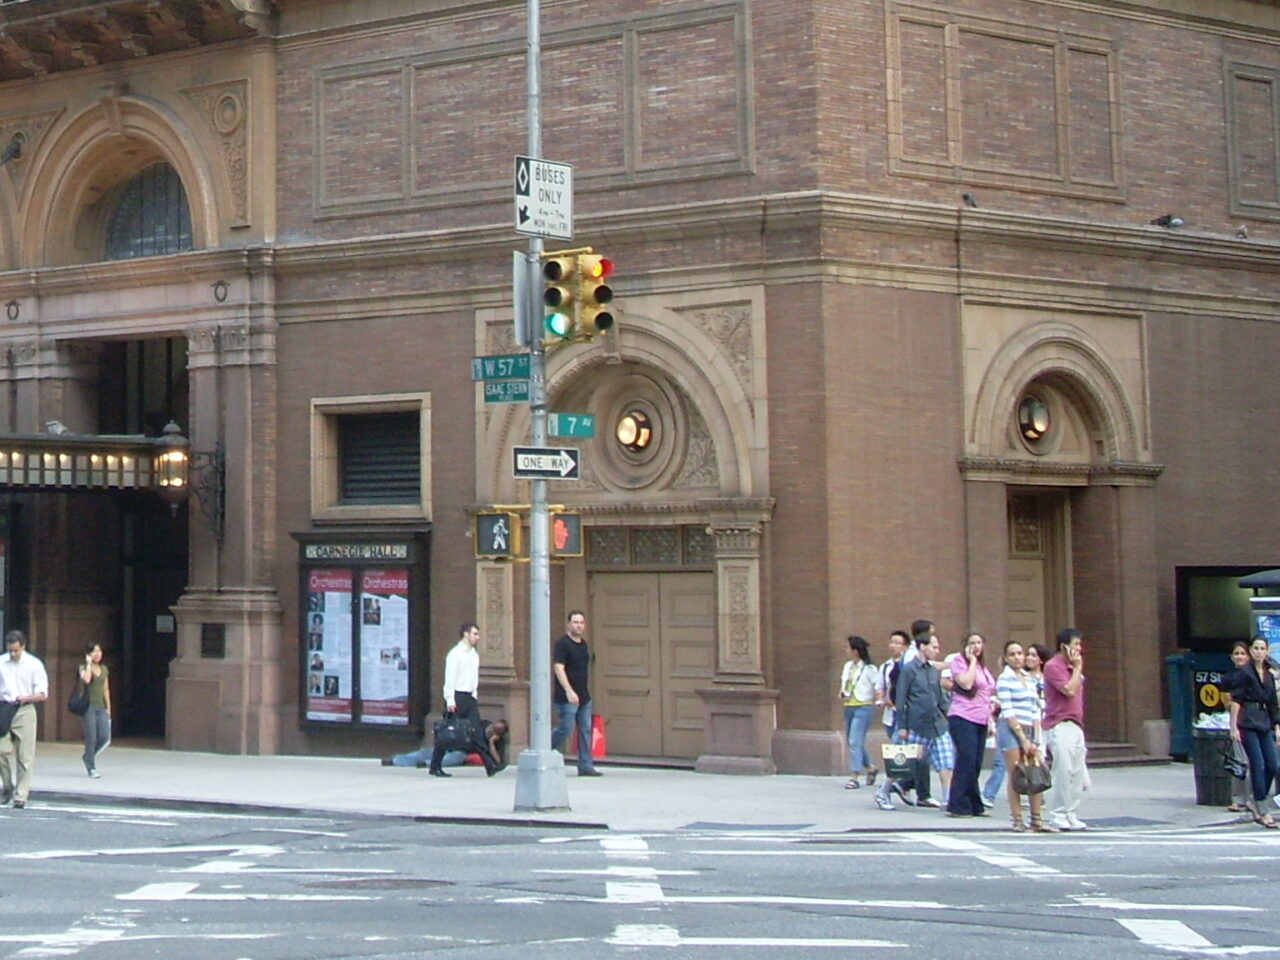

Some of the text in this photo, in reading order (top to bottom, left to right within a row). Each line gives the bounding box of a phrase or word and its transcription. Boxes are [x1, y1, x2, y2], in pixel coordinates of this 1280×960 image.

[535, 167, 565, 185] BUSES
[538, 188, 562, 204] ONLY
[484, 360, 496, 377] W
[498, 358, 514, 376] 57
[486, 381, 527, 396] ISAAC STERN
[567, 417, 577, 435] 7
[522, 456, 570, 470] ONE WAY
[369, 544, 398, 559] HALL
[1195, 671, 1209, 682] 57
[1204, 688, 1215, 701] N
